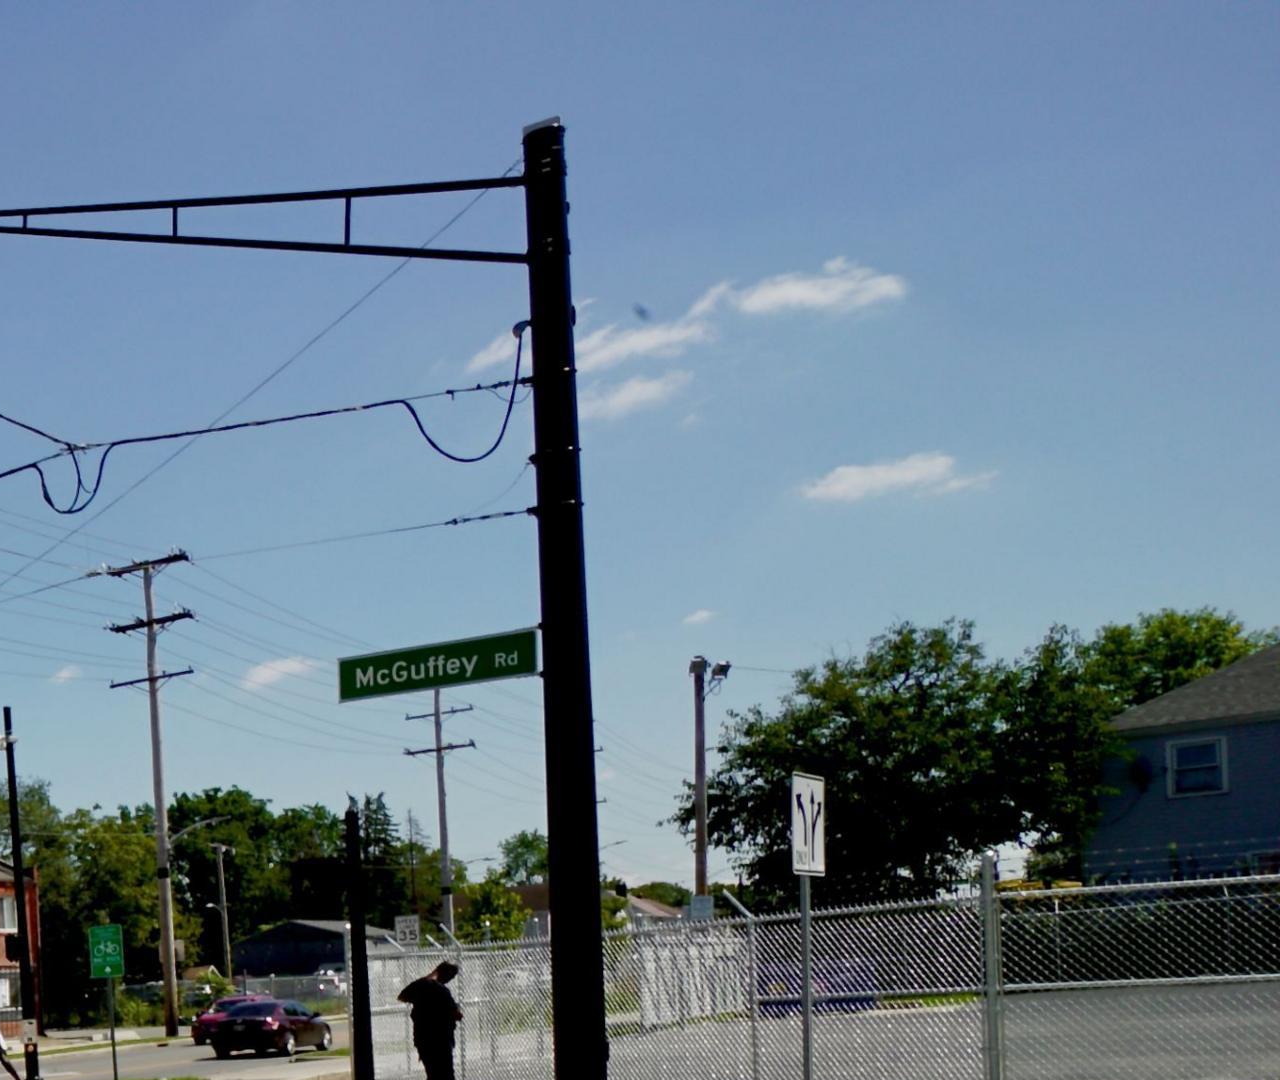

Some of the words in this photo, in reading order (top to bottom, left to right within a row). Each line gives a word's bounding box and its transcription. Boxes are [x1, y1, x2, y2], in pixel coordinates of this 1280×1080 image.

[355, 655, 479, 688] McGuffey
[494, 650, 519, 668] Rd
[399, 929, 417, 941] 35
